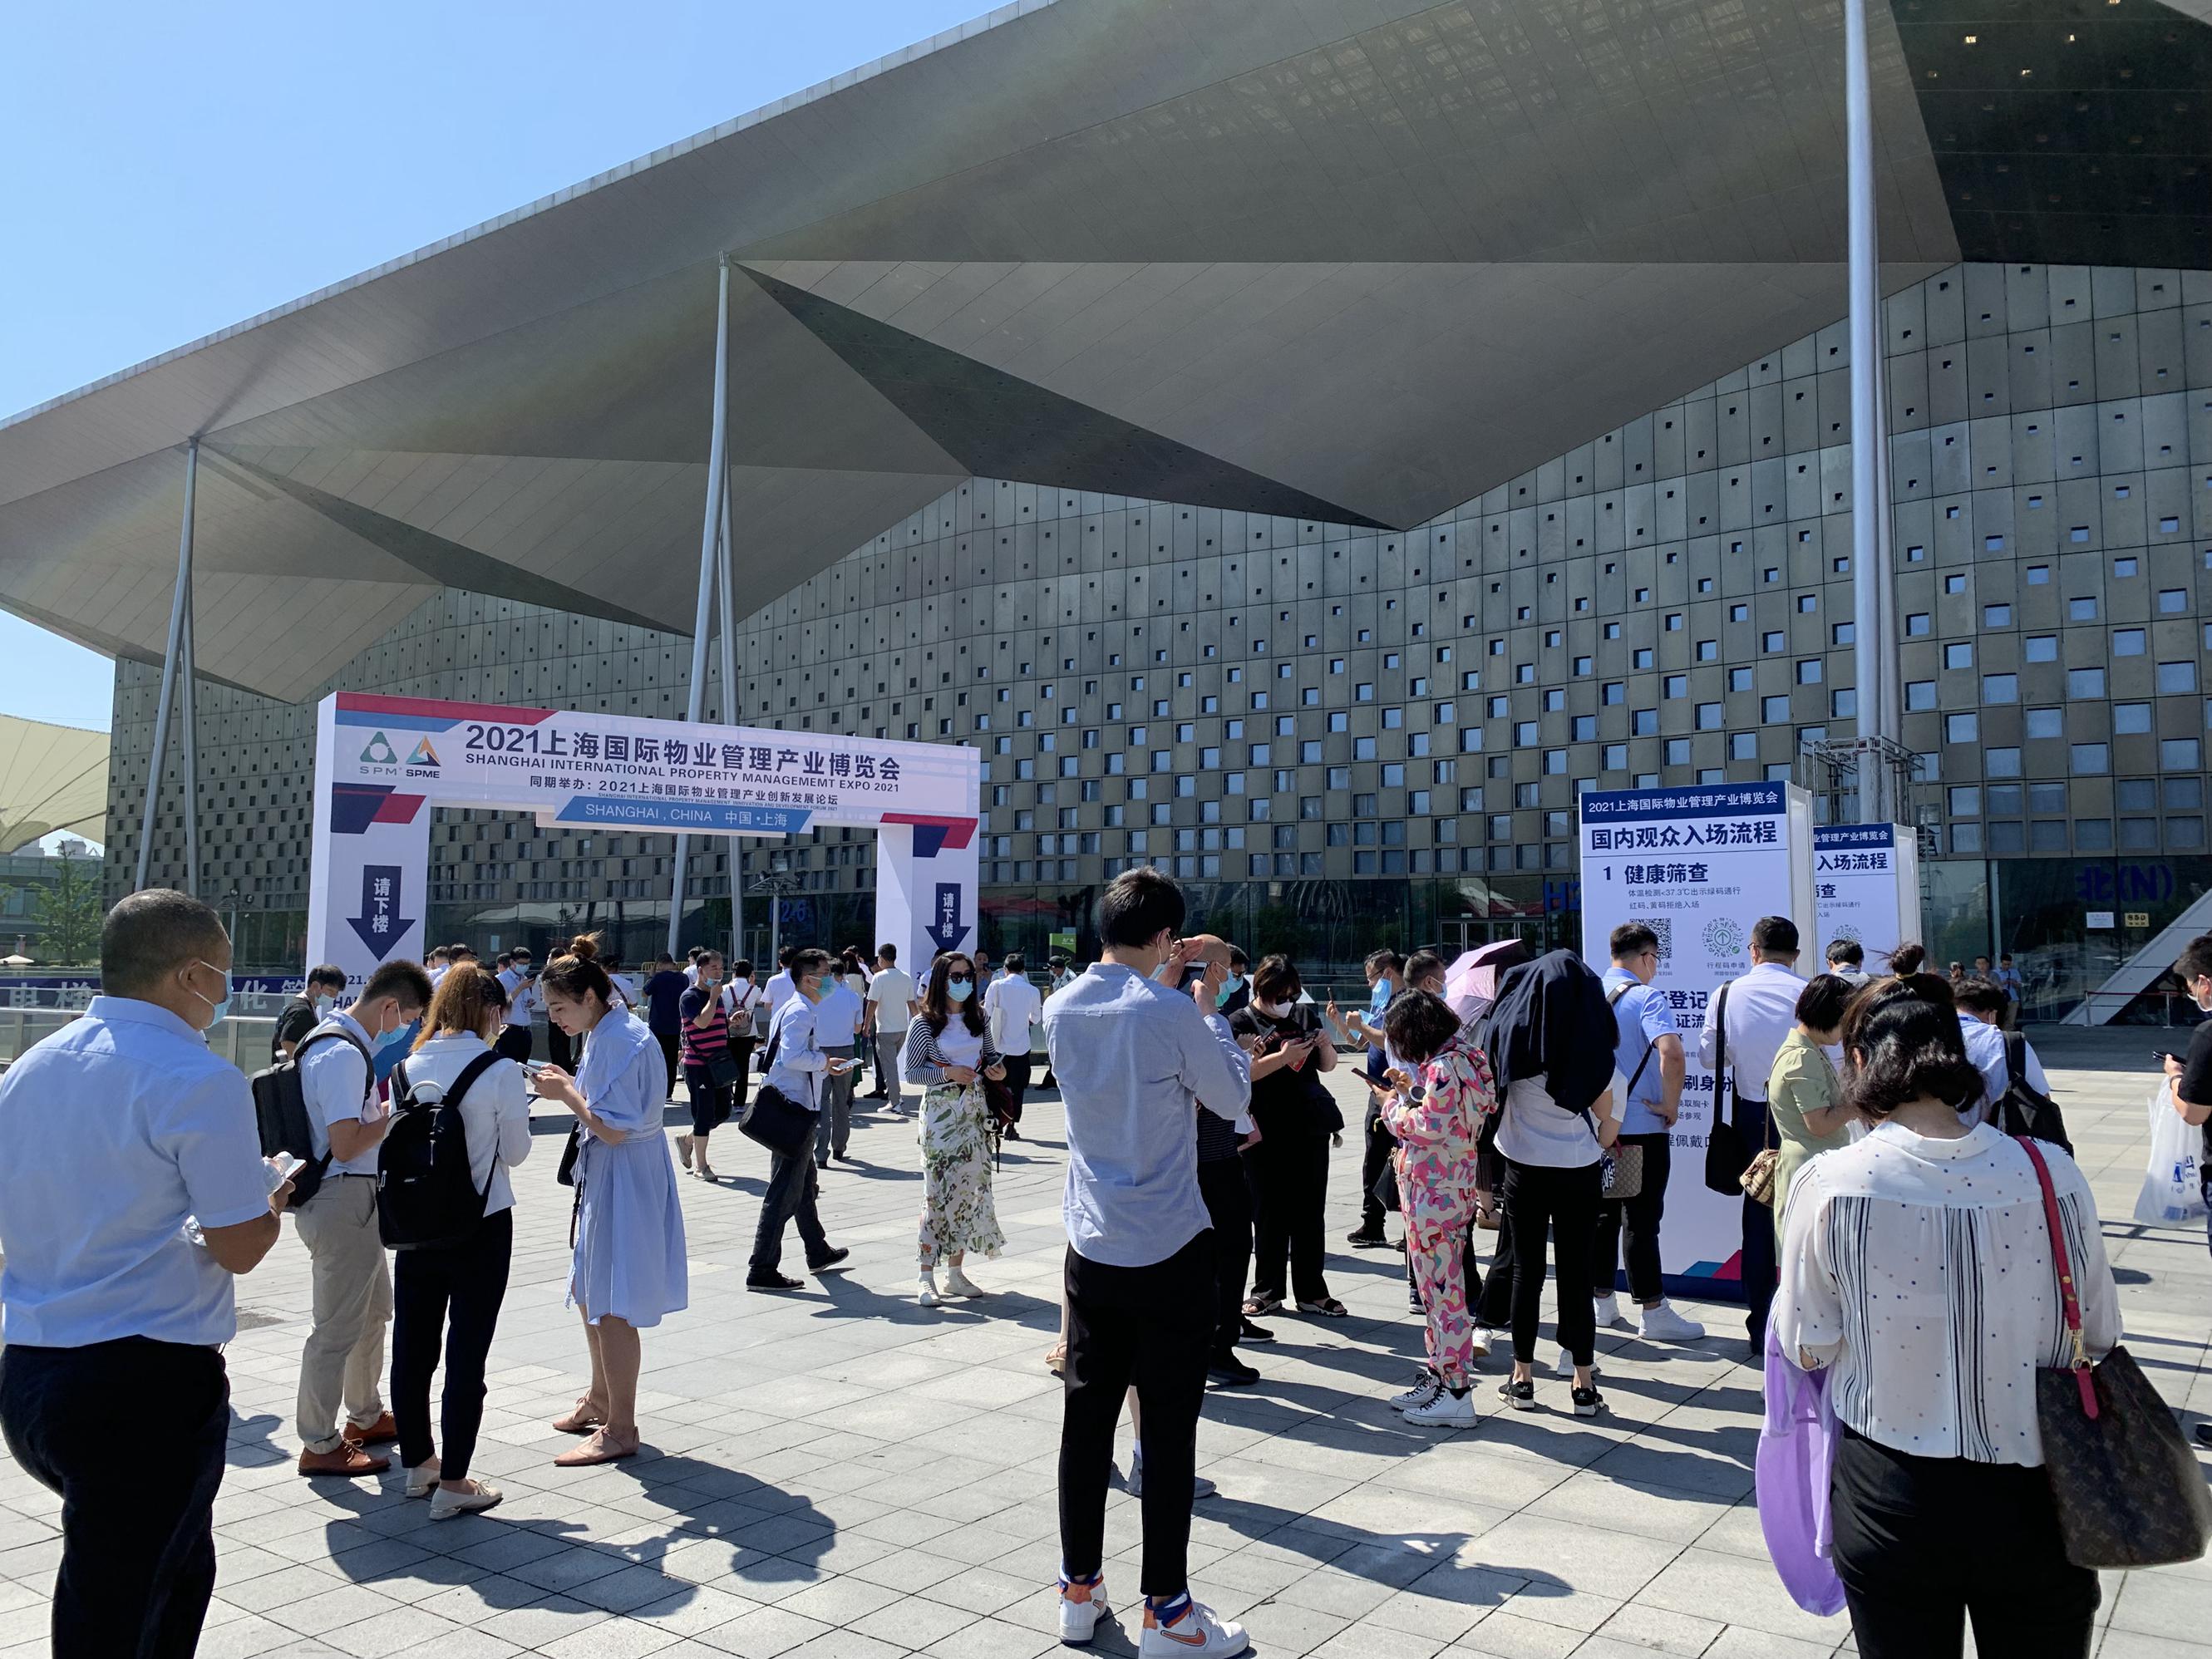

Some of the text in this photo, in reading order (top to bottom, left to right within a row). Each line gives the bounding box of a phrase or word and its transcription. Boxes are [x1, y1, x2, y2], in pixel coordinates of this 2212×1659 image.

[466, 725, 900, 780] 2021上海国际物业管理产业博览会
[360, 766, 397, 776] SPM
[406, 769, 441, 779] SPME
[466, 753, 545, 768] SHANGHAI
[550, 759, 665, 777] INTERNATIONAL
[670, 768, 738, 782] PROPERTY
[840, 780, 870, 790] EXPO
[874, 782, 899, 792] 2021
[627, 794, 668, 802] INTERNATIONAL
[1589, 790, 1778, 814] 2021上海国际物业管理产业博览会
[670, 809, 712, 821] CHINA
[1591, 820, 1777, 850] 国内观众入场流程
[1816, 852, 1888, 871] 入场流程
[1603, 862, 1709, 885] 1 健康筛查
[1815, 883, 1836, 898] 查
[372, 877, 392, 933] 请下楼
[942, 893, 954, 938] 请下楼
